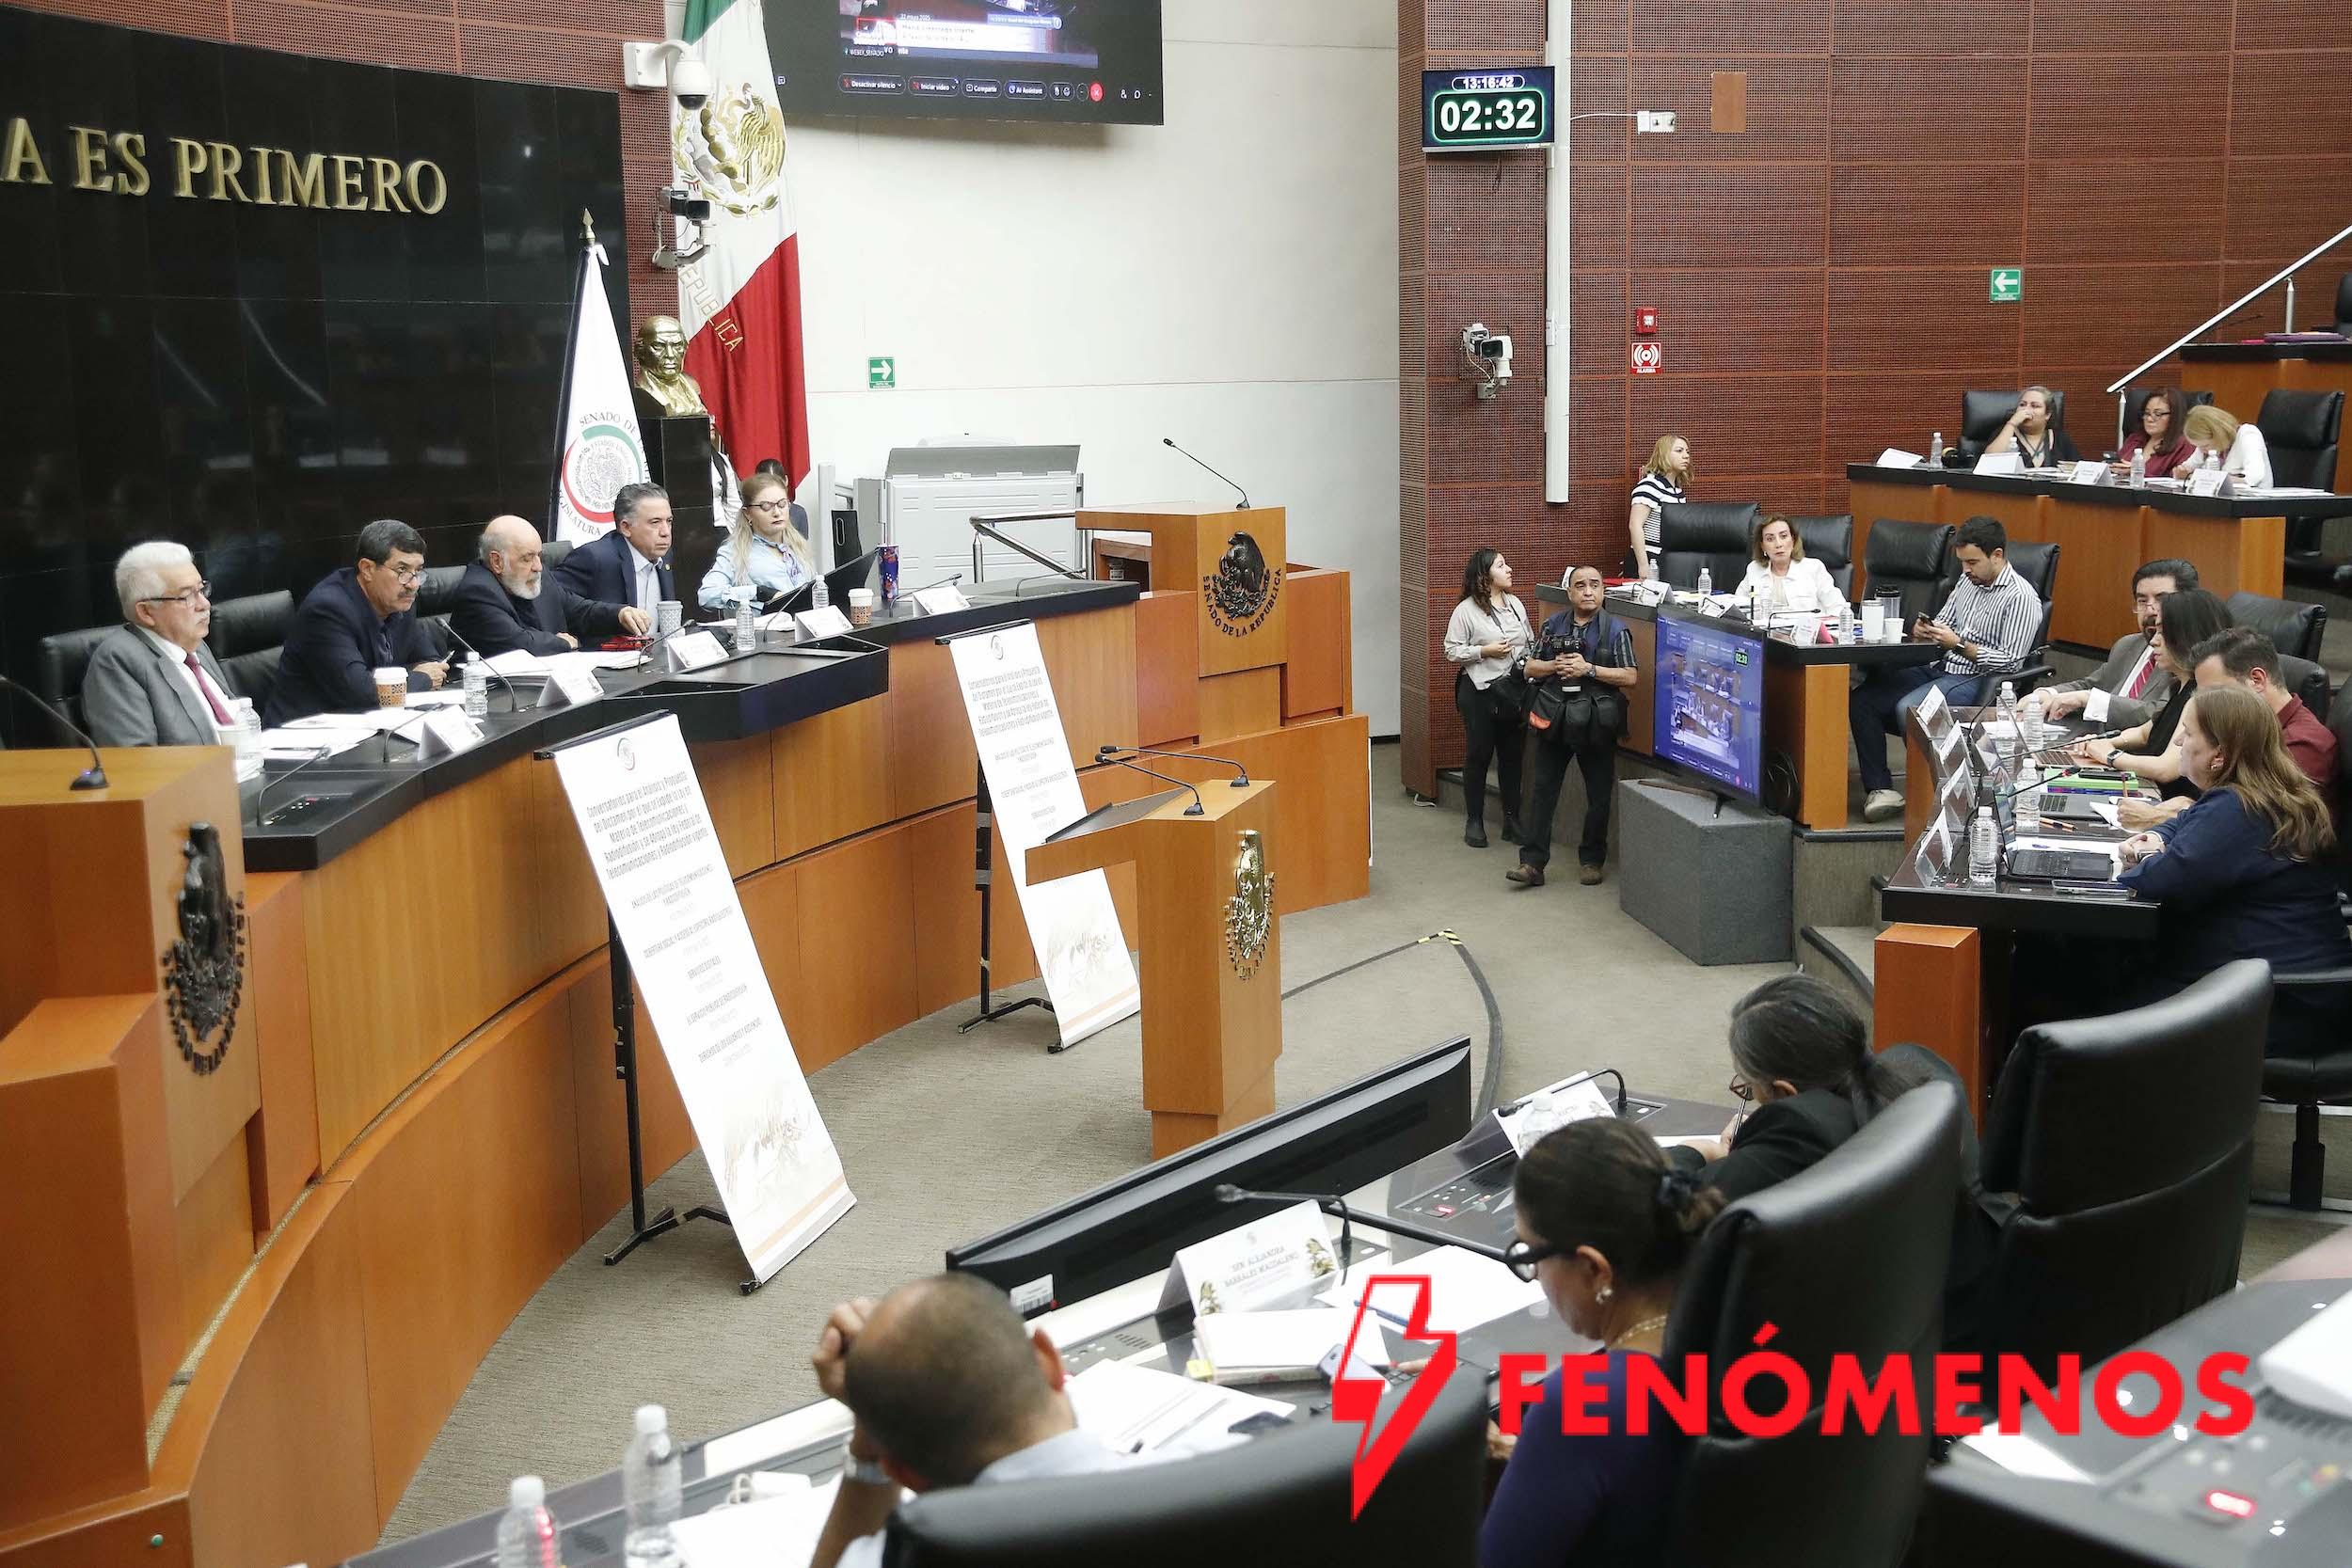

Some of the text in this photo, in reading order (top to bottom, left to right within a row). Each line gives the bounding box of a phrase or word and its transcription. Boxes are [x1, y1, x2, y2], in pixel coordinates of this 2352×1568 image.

[1462, 77, 1515, 90] 13:16:42
[1439, 98, 1536, 133] 02:32
[0, 117, 448, 215] A ES PRIMERO
[579, 411, 621, 428] SENADO
[1202, 567, 1281, 638] SENADO DE LA REPUBLICA
